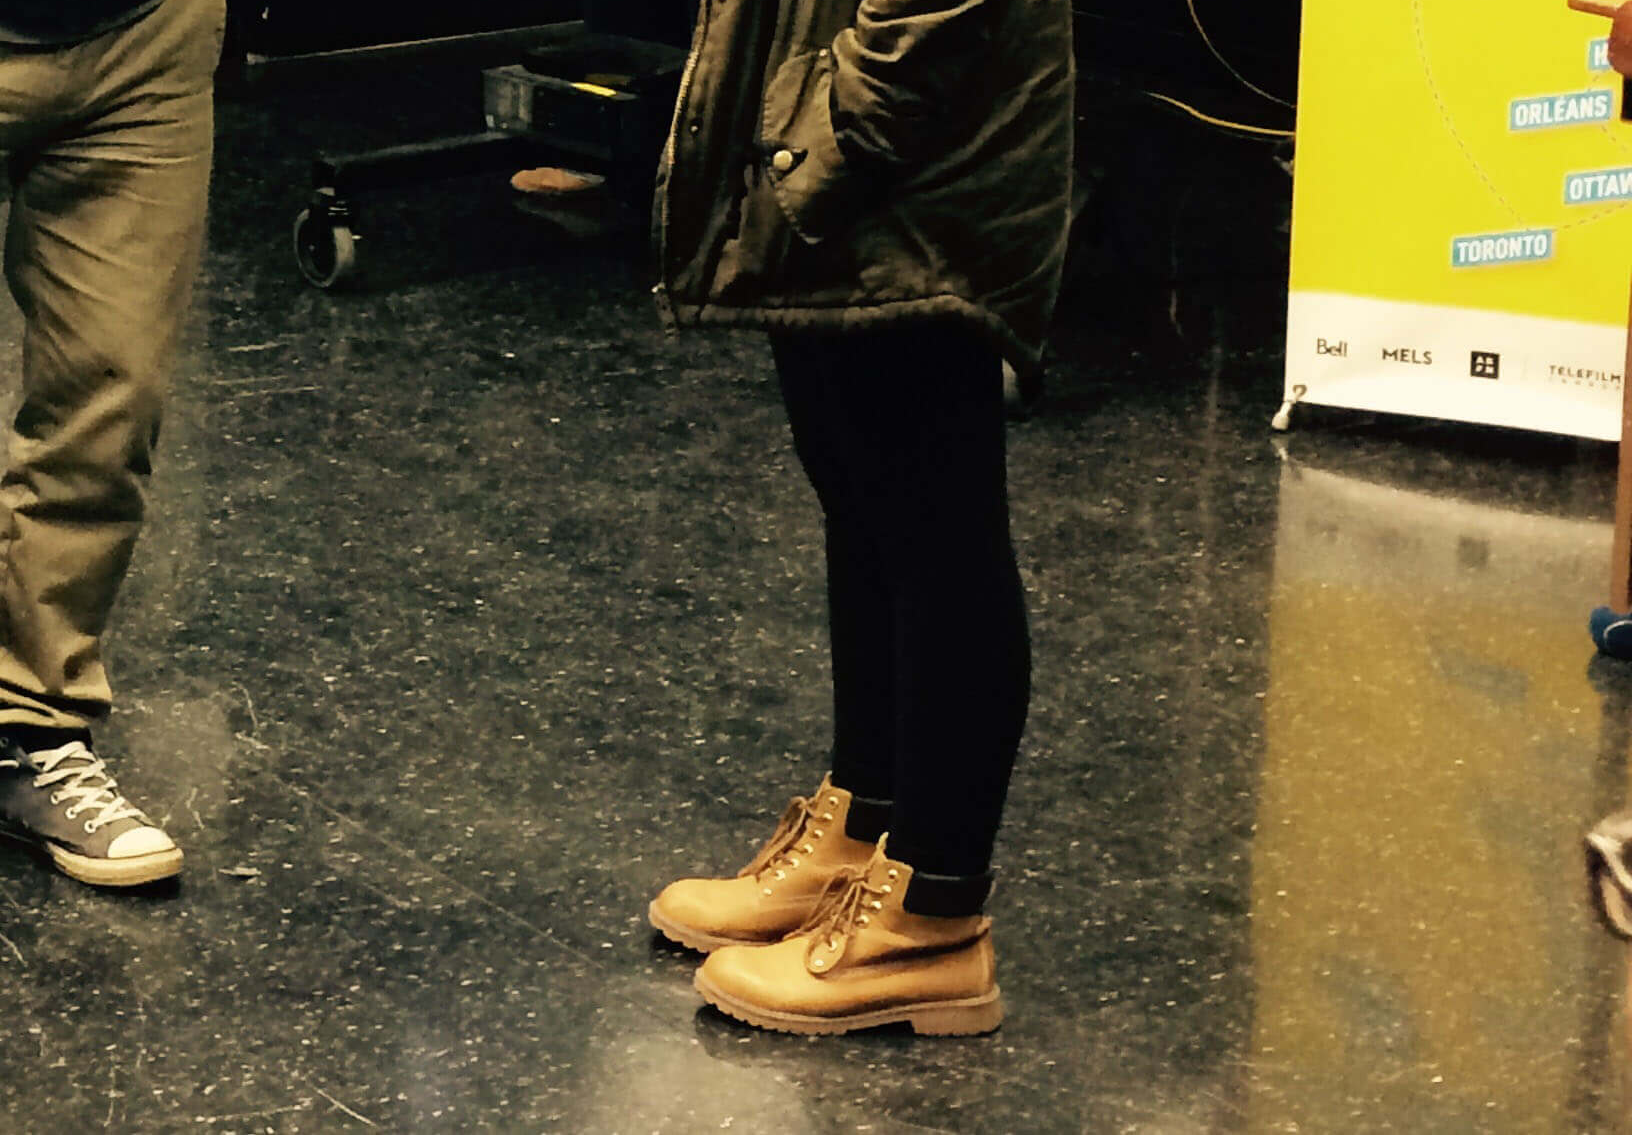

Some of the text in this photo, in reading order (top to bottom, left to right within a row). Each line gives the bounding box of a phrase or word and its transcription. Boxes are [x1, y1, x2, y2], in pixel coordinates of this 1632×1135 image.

[1514, 92, 1609, 127] ORLÉANS
[1456, 231, 1549, 264] TORONTO
[1317, 337, 1348, 357] Bell
[1381, 347, 1433, 366] MELS
[1548, 364, 1622, 384] TELEFILM
